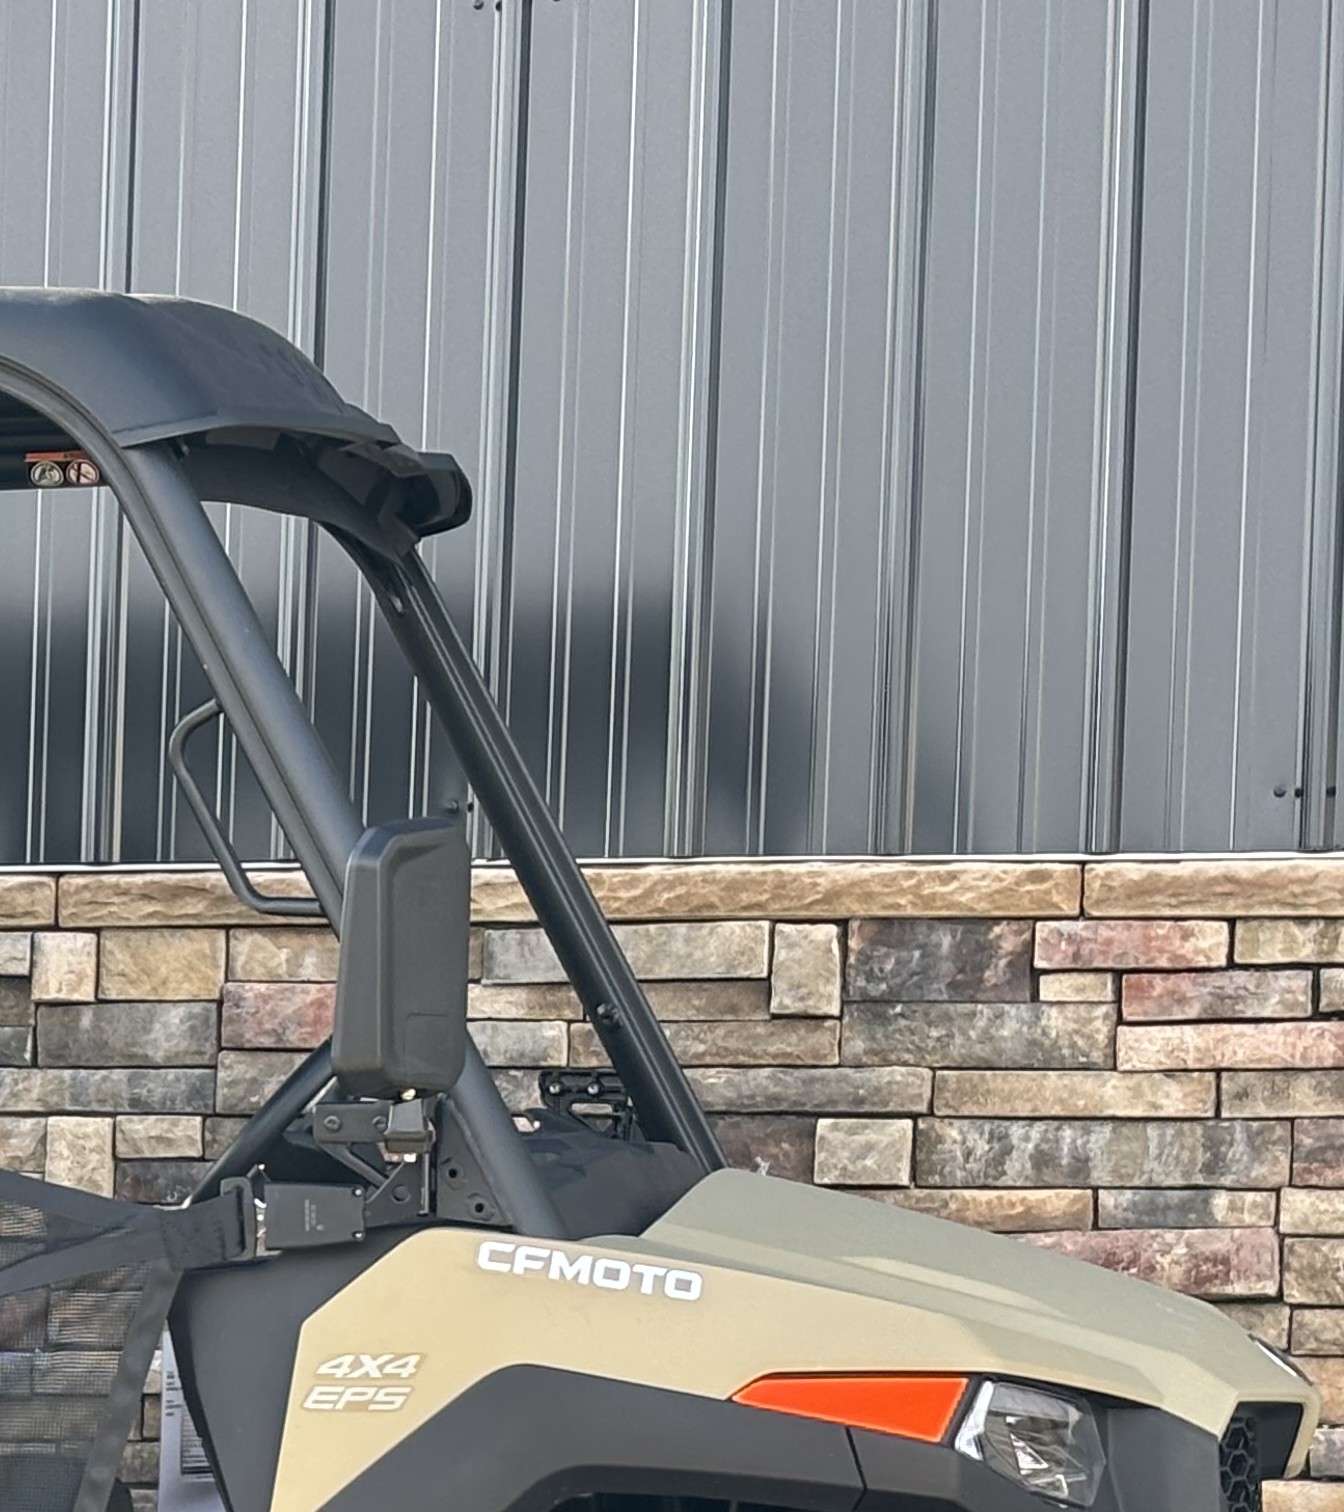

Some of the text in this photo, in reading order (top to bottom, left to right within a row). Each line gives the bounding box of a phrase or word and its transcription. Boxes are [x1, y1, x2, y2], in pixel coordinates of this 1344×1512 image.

[478, 1240, 703, 1301] CFMOTO
[316, 1353, 421, 1378] 4X4
[302, 1386, 412, 1411] EPS
